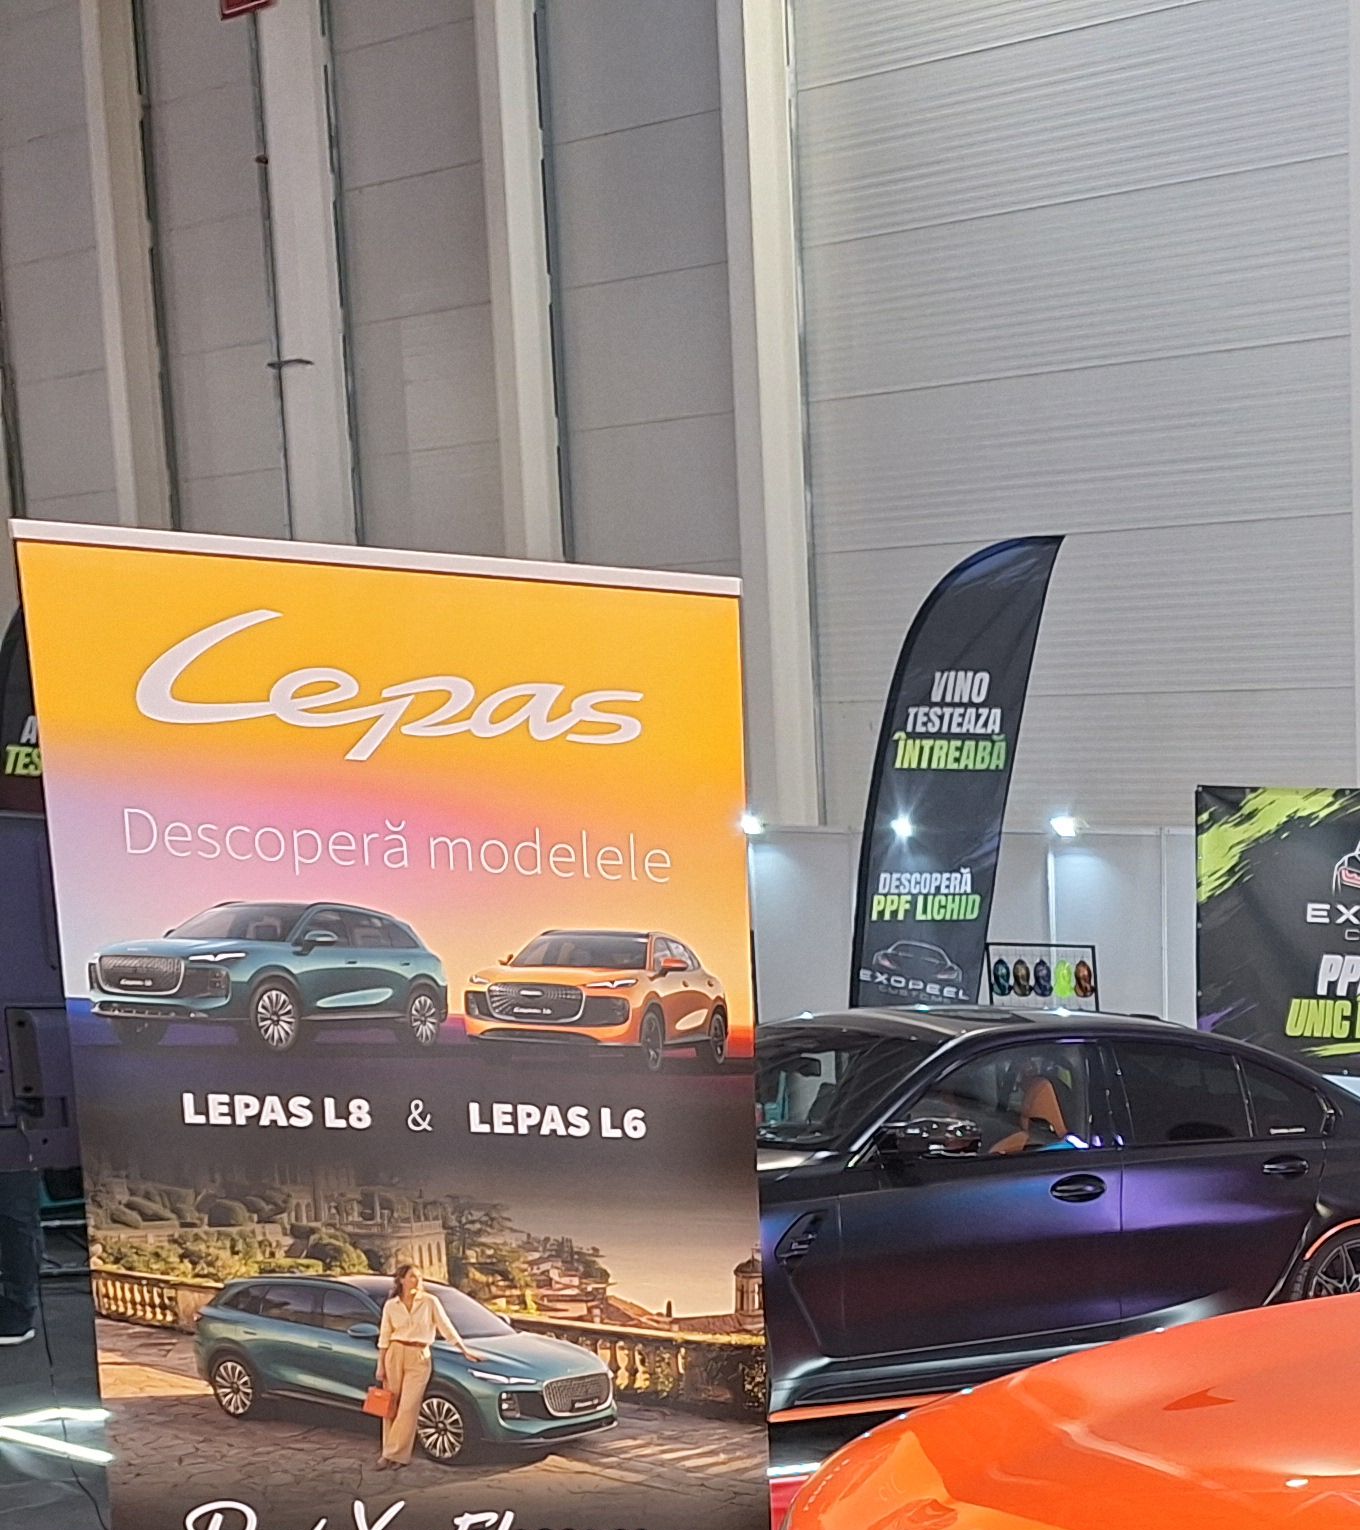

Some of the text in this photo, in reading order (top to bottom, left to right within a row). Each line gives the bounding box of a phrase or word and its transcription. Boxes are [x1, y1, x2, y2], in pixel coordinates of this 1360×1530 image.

[136, 609, 644, 761] Lepas
[931, 671, 990, 703] VINO
[906, 706, 1001, 734] TESTEAZA
[893, 731, 1008, 770] ÎNTREABĂ
[124, 807, 673, 883] Descoperă modelele
[878, 867, 972, 894] DESCOPERĂ
[870, 894, 982, 921] PPF LICHID
[859, 968, 970, 1001] EXOPEEL
[1285, 998, 1352, 1038] UNIC
[182, 1092, 647, 1139] LEPAS L8 & LEPAS L6
